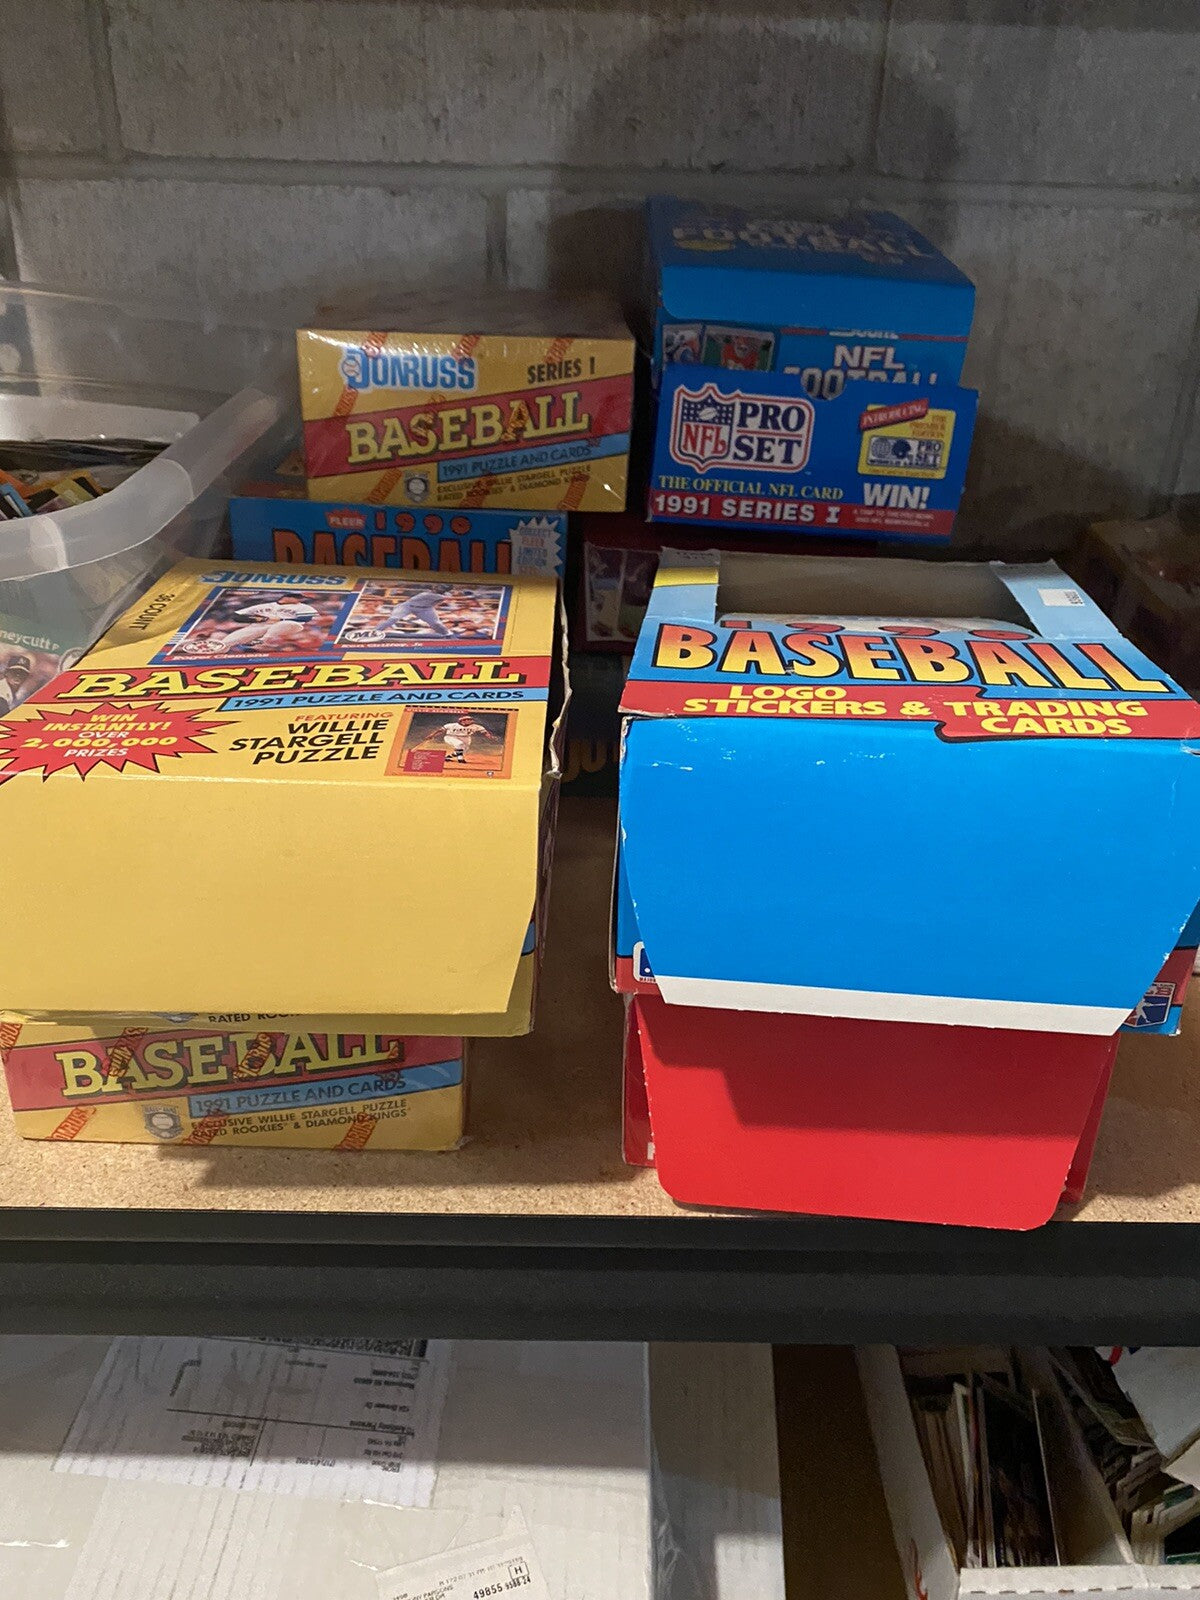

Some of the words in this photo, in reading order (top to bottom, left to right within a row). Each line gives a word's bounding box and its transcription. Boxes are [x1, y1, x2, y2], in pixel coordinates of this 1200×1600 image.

[834, 344, 905, 369] NFL
[527, 363, 583, 384] SERIES
[346, 391, 590, 463] BASEBALL
[737, 402, 806, 432] PRO
[682, 423, 727, 456] NFL
[732, 435, 802, 464] SET
[442, 463, 468, 477] 1991
[472, 458, 517, 473] PUZZLE
[521, 452, 548, 466] AND
[551, 445, 592, 462] CARDS
[658, 475, 691, 490] THE
[692, 478, 765, 495] OFFICIAL
[768, 483, 798, 498] NFL
[801, 485, 844, 501] CARD
[863, 482, 931, 509] WIN!
[655, 494, 711, 515] 1991
[721, 498, 816, 522] SERIES
[329, 516, 363, 526] FLEER
[375, 510, 472, 537] 1990
[652, 623, 1176, 694] BASEBALL
[57, 660, 523, 700] BASEBALL
[232, 697, 283, 709] 1991
[290, 693, 384, 705] PUZZLE
[386, 691, 443, 701] AND
[445, 689, 525, 701] CARDS
[729, 685, 848, 700] LOGO
[90, 713, 138, 722] WIN
[294, 711, 395, 722] FEATURING
[682, 699, 888, 715] STICKERS
[900, 701, 935, 716] &
[943, 700, 1149, 717] TRADING
[42, 721, 173, 732] INSTANTLY!
[78, 731, 129, 739] OVER
[287, 719, 390, 734] WILLIE
[980, 716, 1133, 735] CARDS
[20, 737, 178, 750] 2,000,000
[228, 731, 385, 751] STARGELL
[63, 748, 129, 758] PRIZES
[252, 746, 379, 765] PUZZLE
[55, 1032, 403, 1098] BASEBALL
[195, 1098, 231, 1111] 1991
[237, 1089, 300, 1107] PUZZLE
[301, 1085, 344, 1101] AND
[347, 1076, 406, 1094] CARDS
[258, 1113, 296, 1124] WILLIE
[301, 1106, 356, 1120] STARGELL
[362, 1099, 407, 1112] PUZZLE
[293, 1121, 301, 1129] &
[306, 1114, 366, 1129] DIAMOND
[514, 1566, 523, 1575] H
[473, 1582, 503, 1600] 49855
